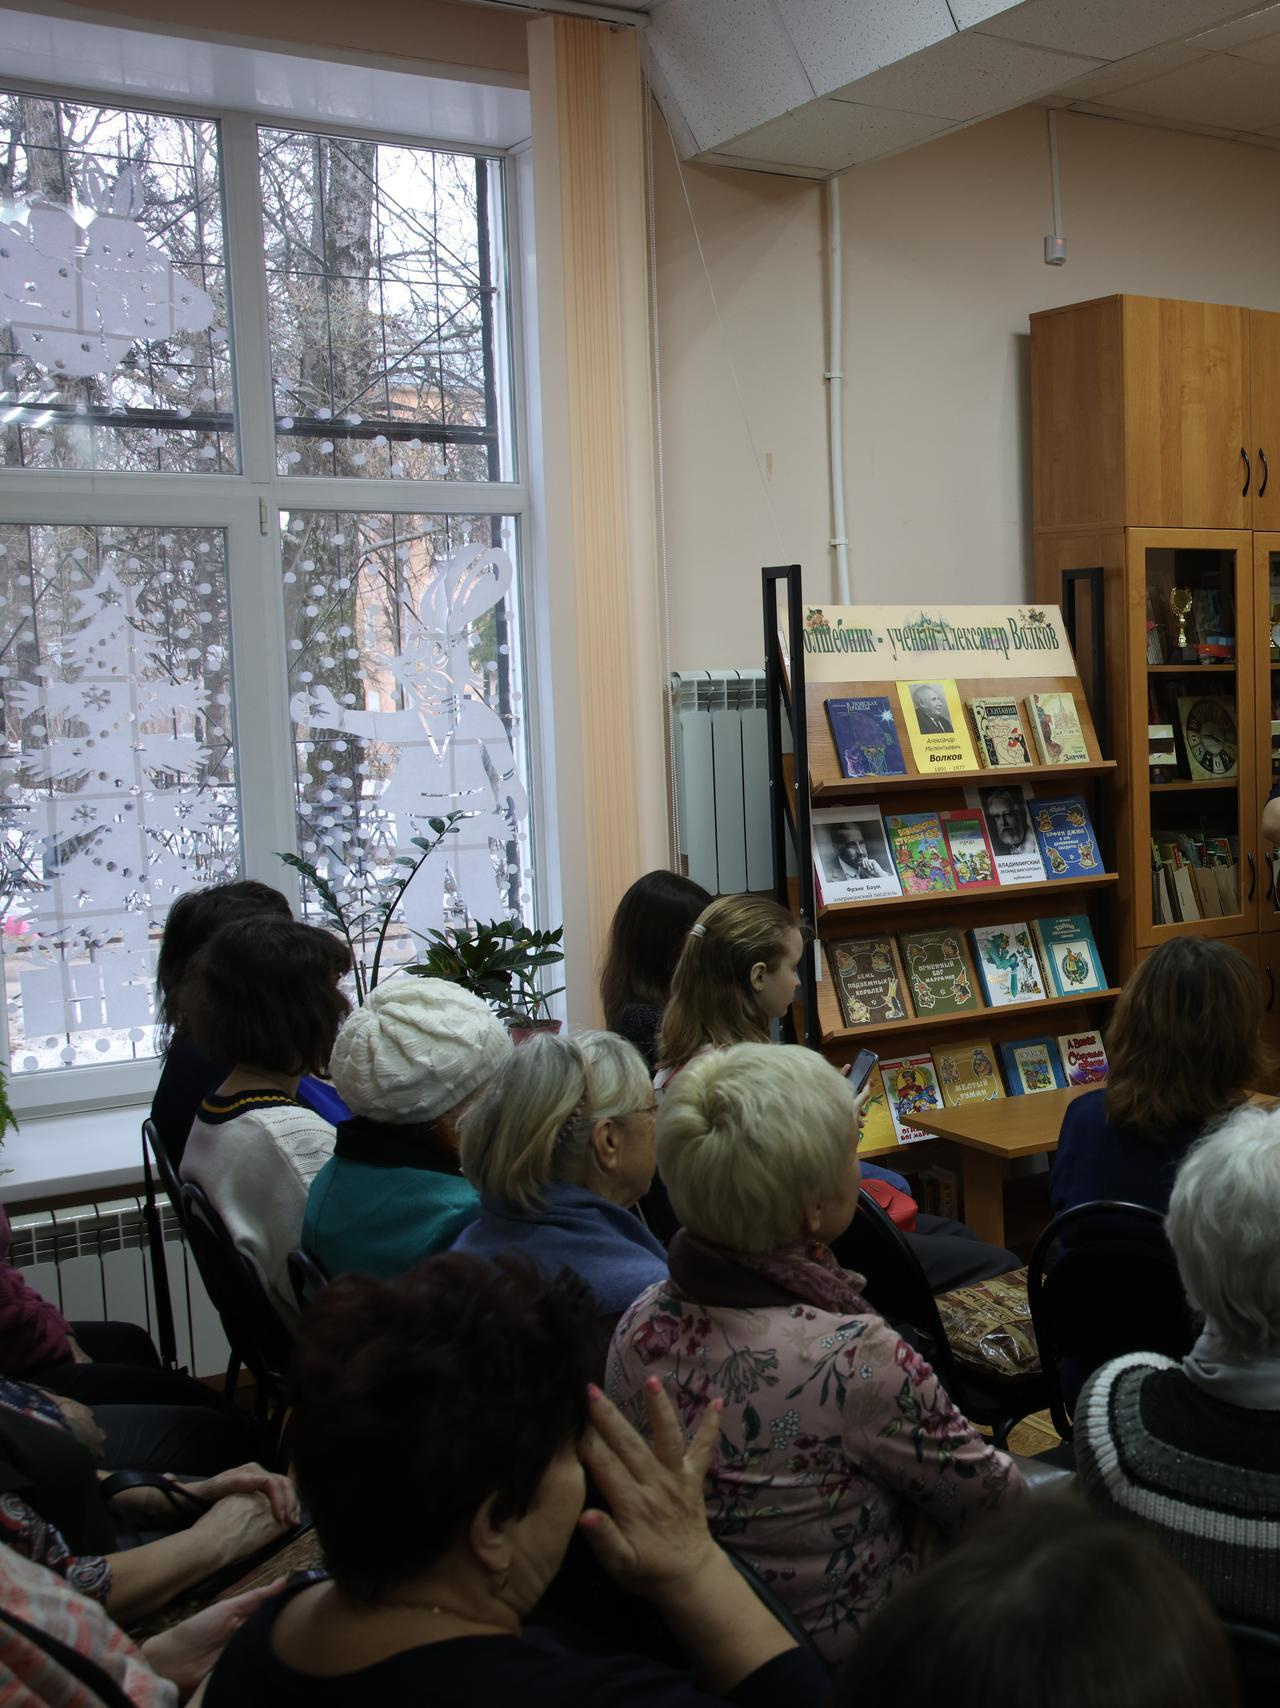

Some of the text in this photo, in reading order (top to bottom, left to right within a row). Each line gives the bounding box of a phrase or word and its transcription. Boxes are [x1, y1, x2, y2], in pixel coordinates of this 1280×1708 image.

[802, 619, 876, 654] олшебник
[940, 618, 1010, 660] Александр
[1007, 617, 1060, 650] Волков
[930, 754, 963, 762] Волков
[998, 859, 1041, 868] ВЛАДИМИРСКИЙ
[847, 884, 881, 894] Фрэнк Баум
